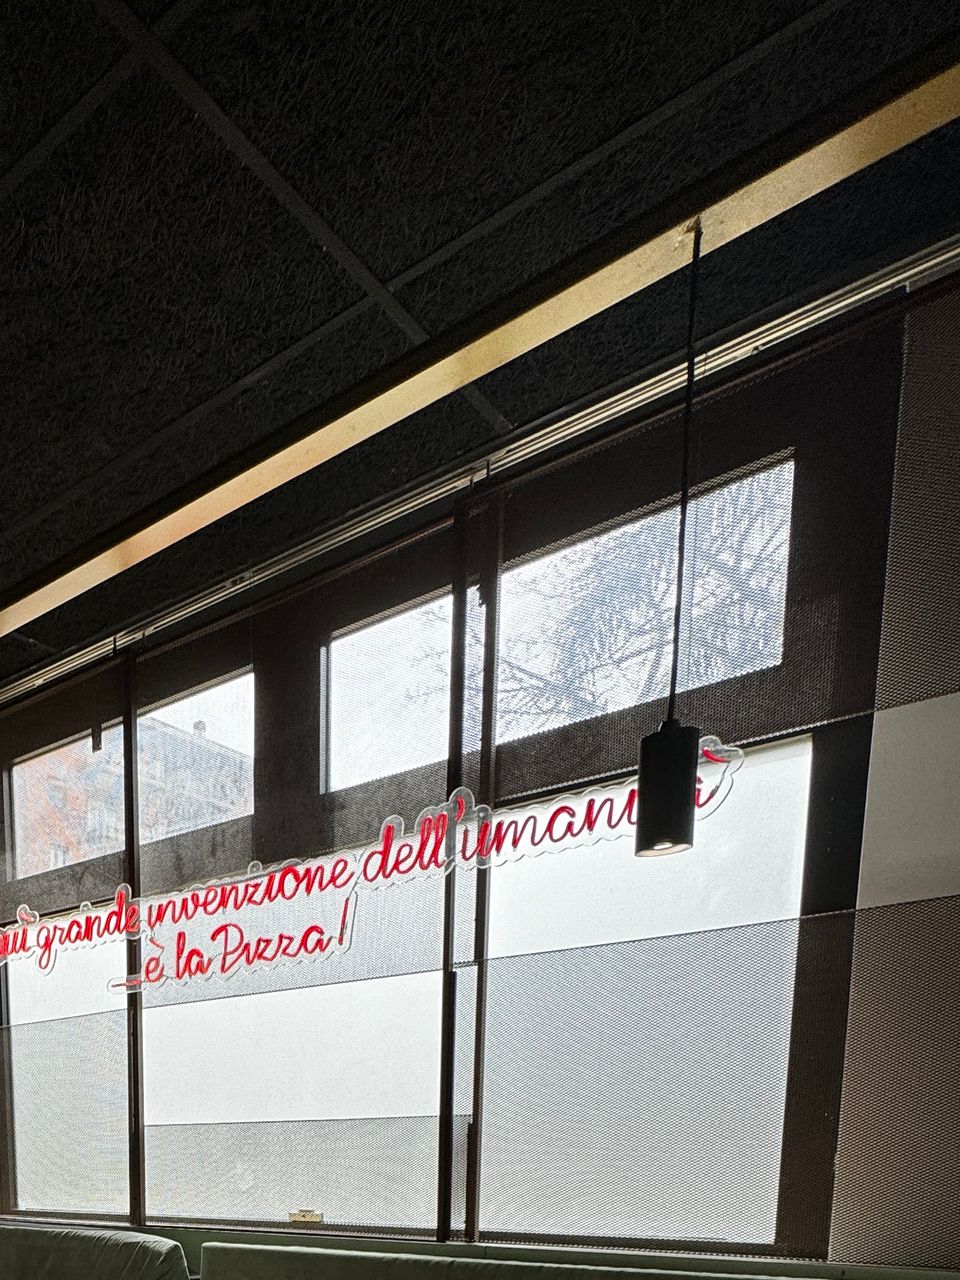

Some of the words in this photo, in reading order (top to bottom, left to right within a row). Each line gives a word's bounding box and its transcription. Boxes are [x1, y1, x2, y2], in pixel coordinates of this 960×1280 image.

[37, 889, 141, 969] grande
[147, 857, 355, 929] invenzione
[362, 747, 728, 883] dell'umani
[175, 931, 213, 980] la
